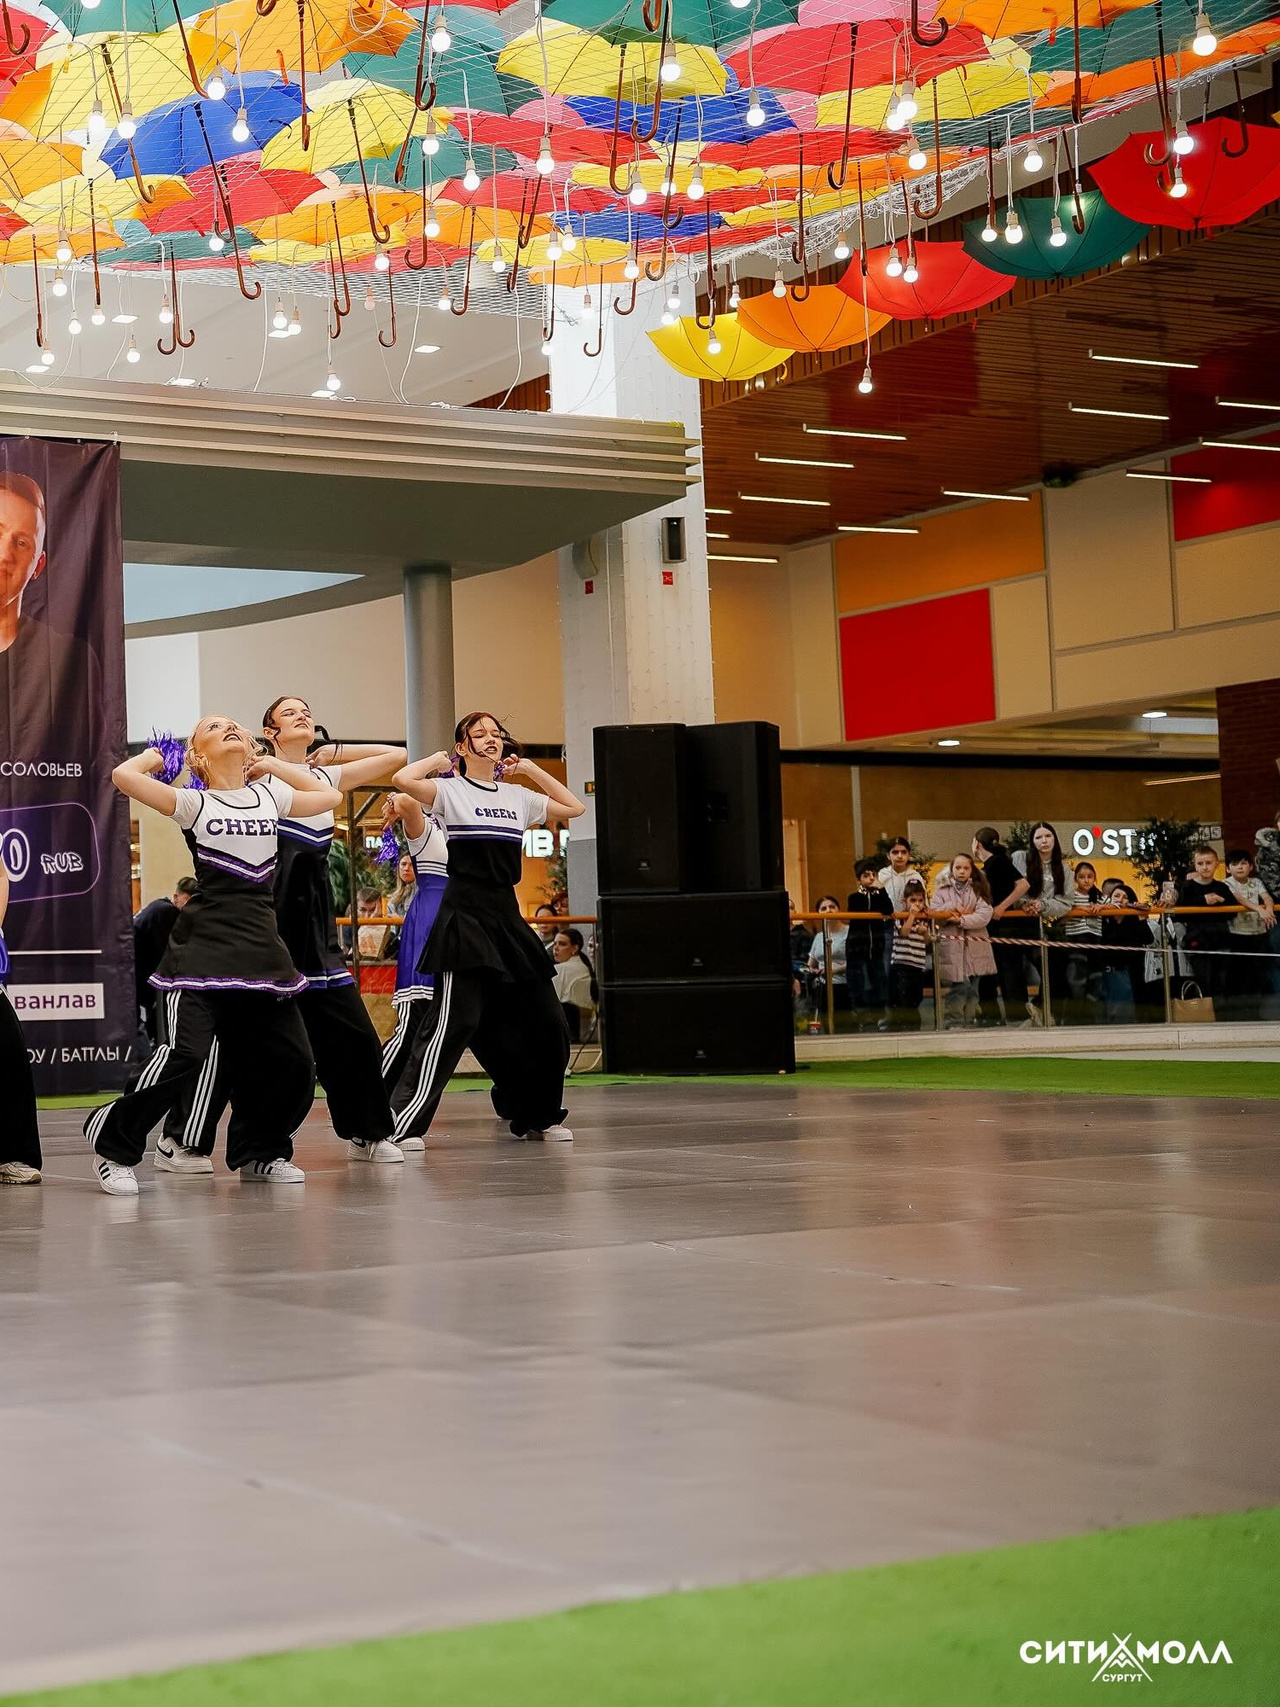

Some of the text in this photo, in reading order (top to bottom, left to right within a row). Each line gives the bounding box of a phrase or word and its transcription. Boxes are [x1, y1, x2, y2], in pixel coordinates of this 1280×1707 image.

[0, 761, 83, 777] СОЛОВЬЕВ
[40, 852, 83, 875] RUB
[14, 994, 96, 1010] ванлав
[61, 1046, 120, 1063] БАТТЛЫ
